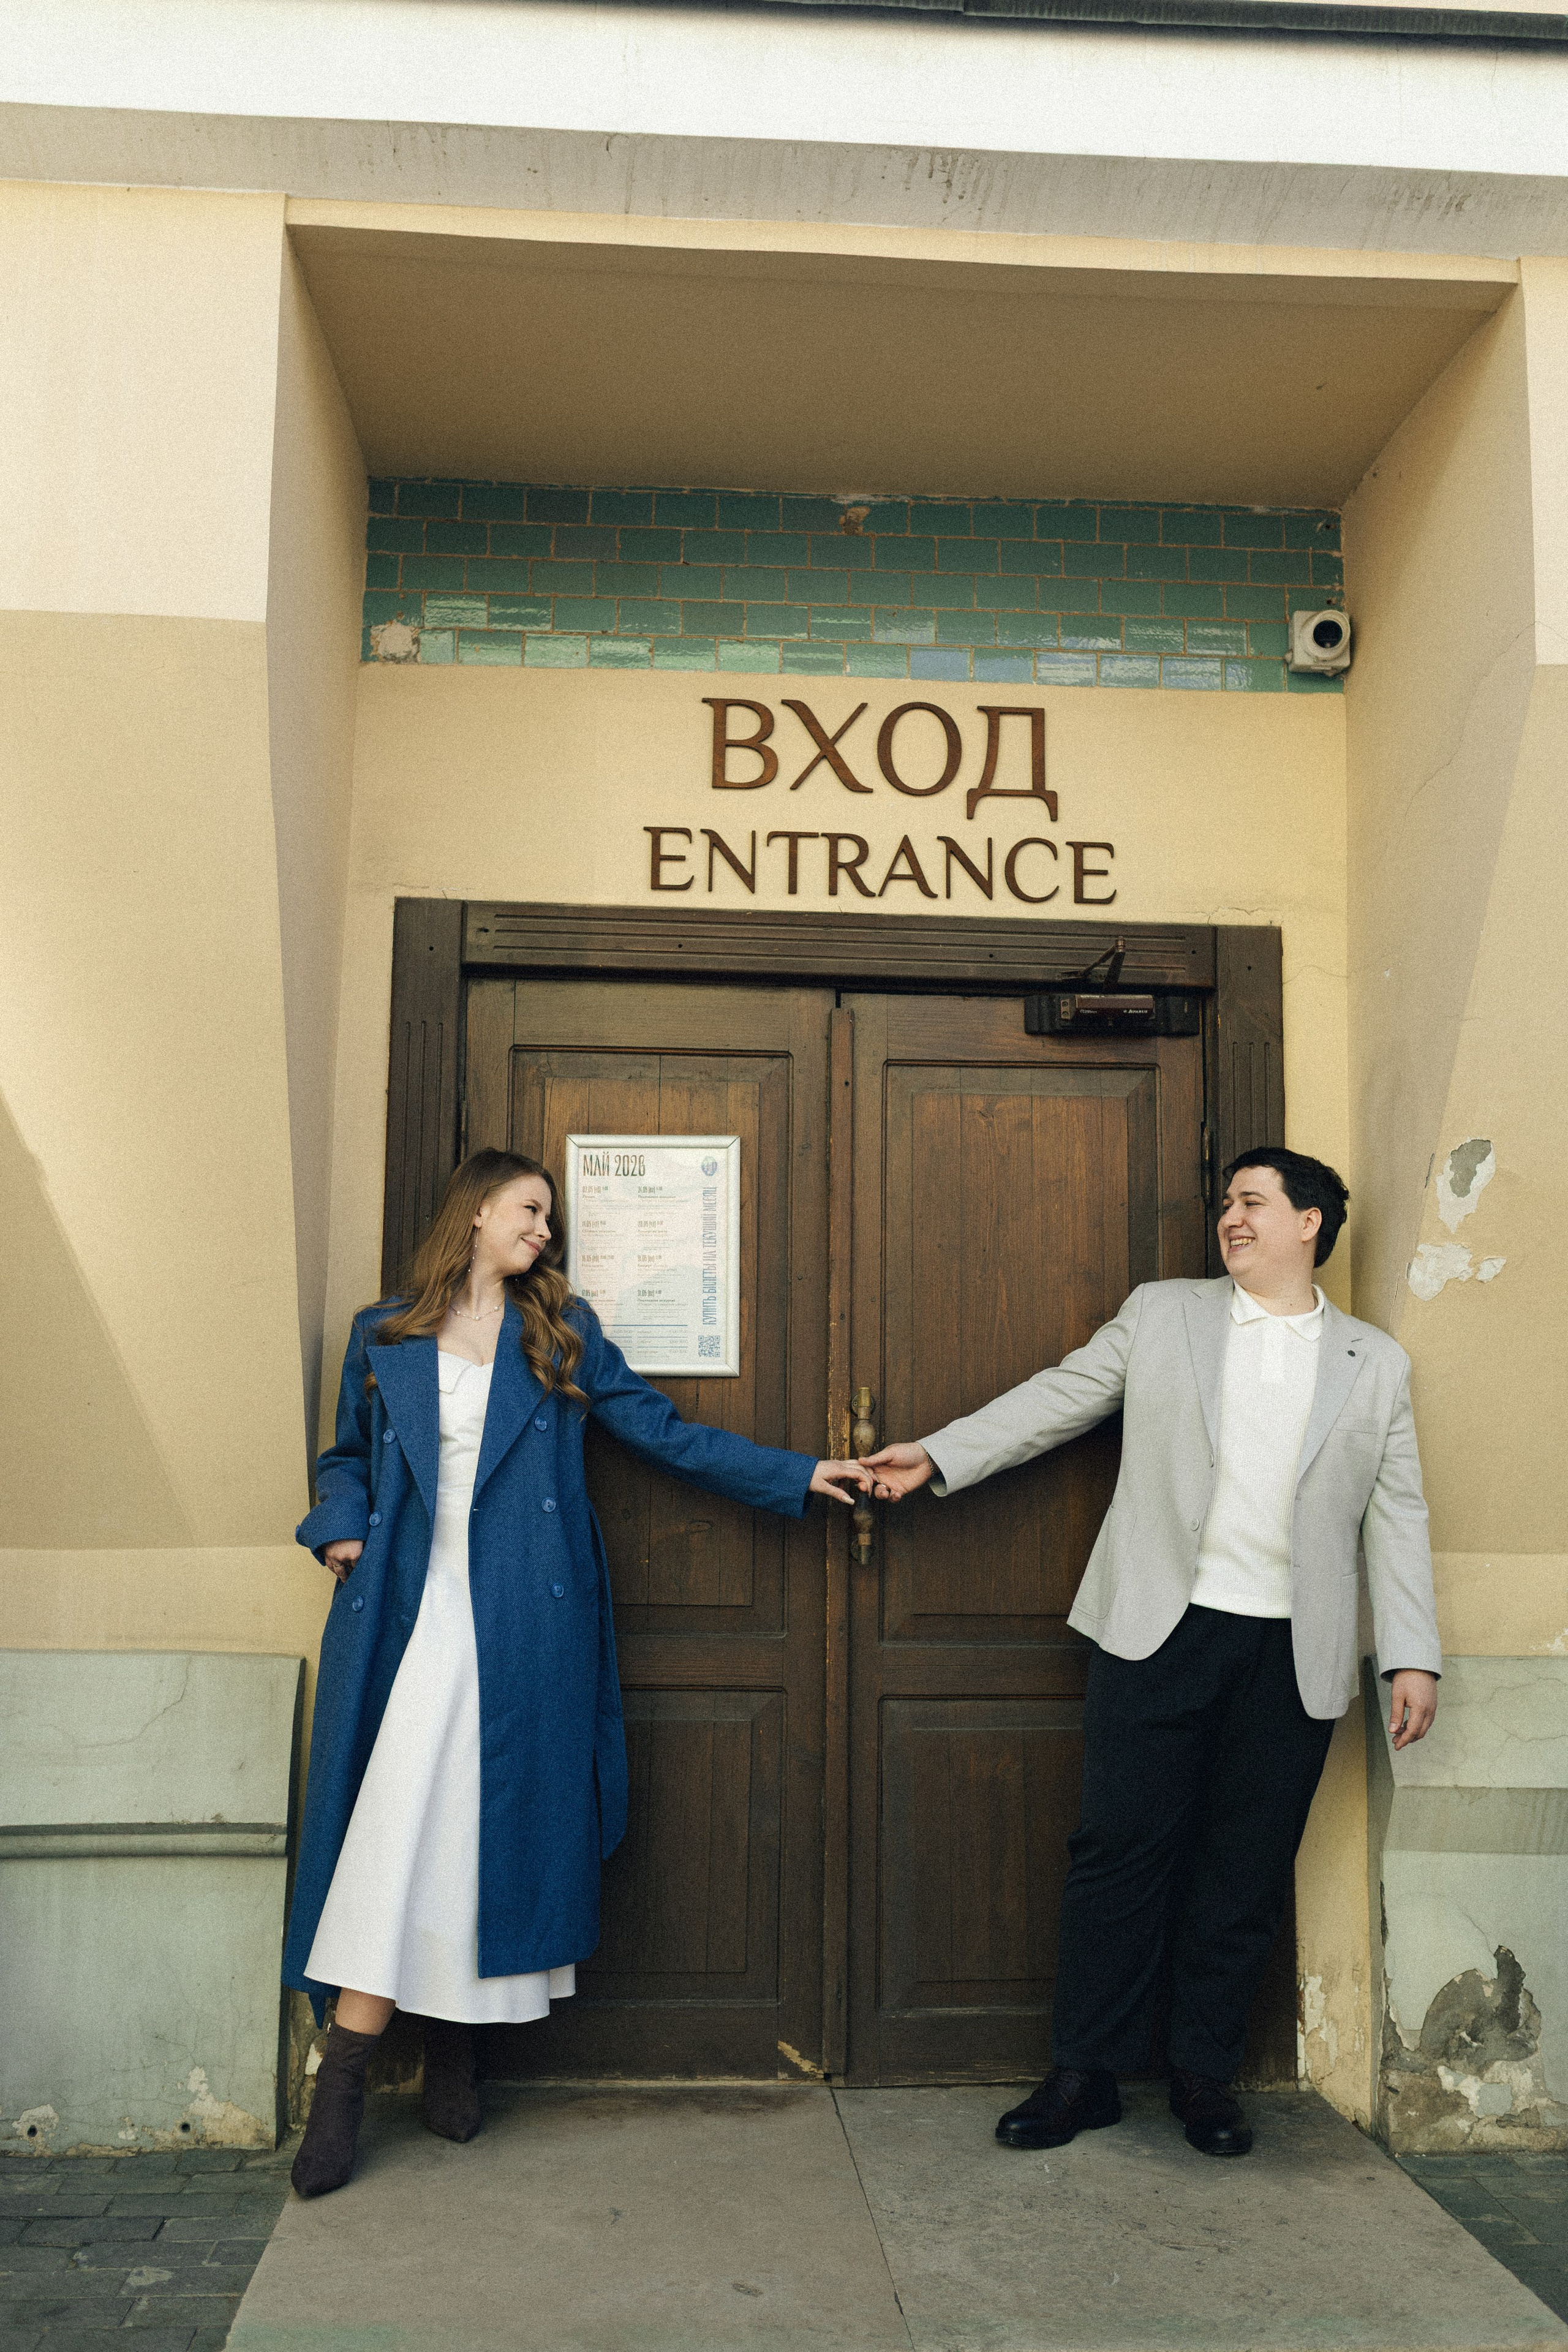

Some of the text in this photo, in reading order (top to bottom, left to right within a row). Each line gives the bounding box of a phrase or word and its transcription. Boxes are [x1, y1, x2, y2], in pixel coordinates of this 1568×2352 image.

[701, 697, 1058, 821] ВХОД
[643, 826, 1117, 905] ENTRANCE
[583, 1152, 646, 1177] МАЙ 2026
[701, 1186, 717, 1325] КУПИТЬ БИЛЕТЫ НА ТЕКУЩИЙ МЕСЯЦ
